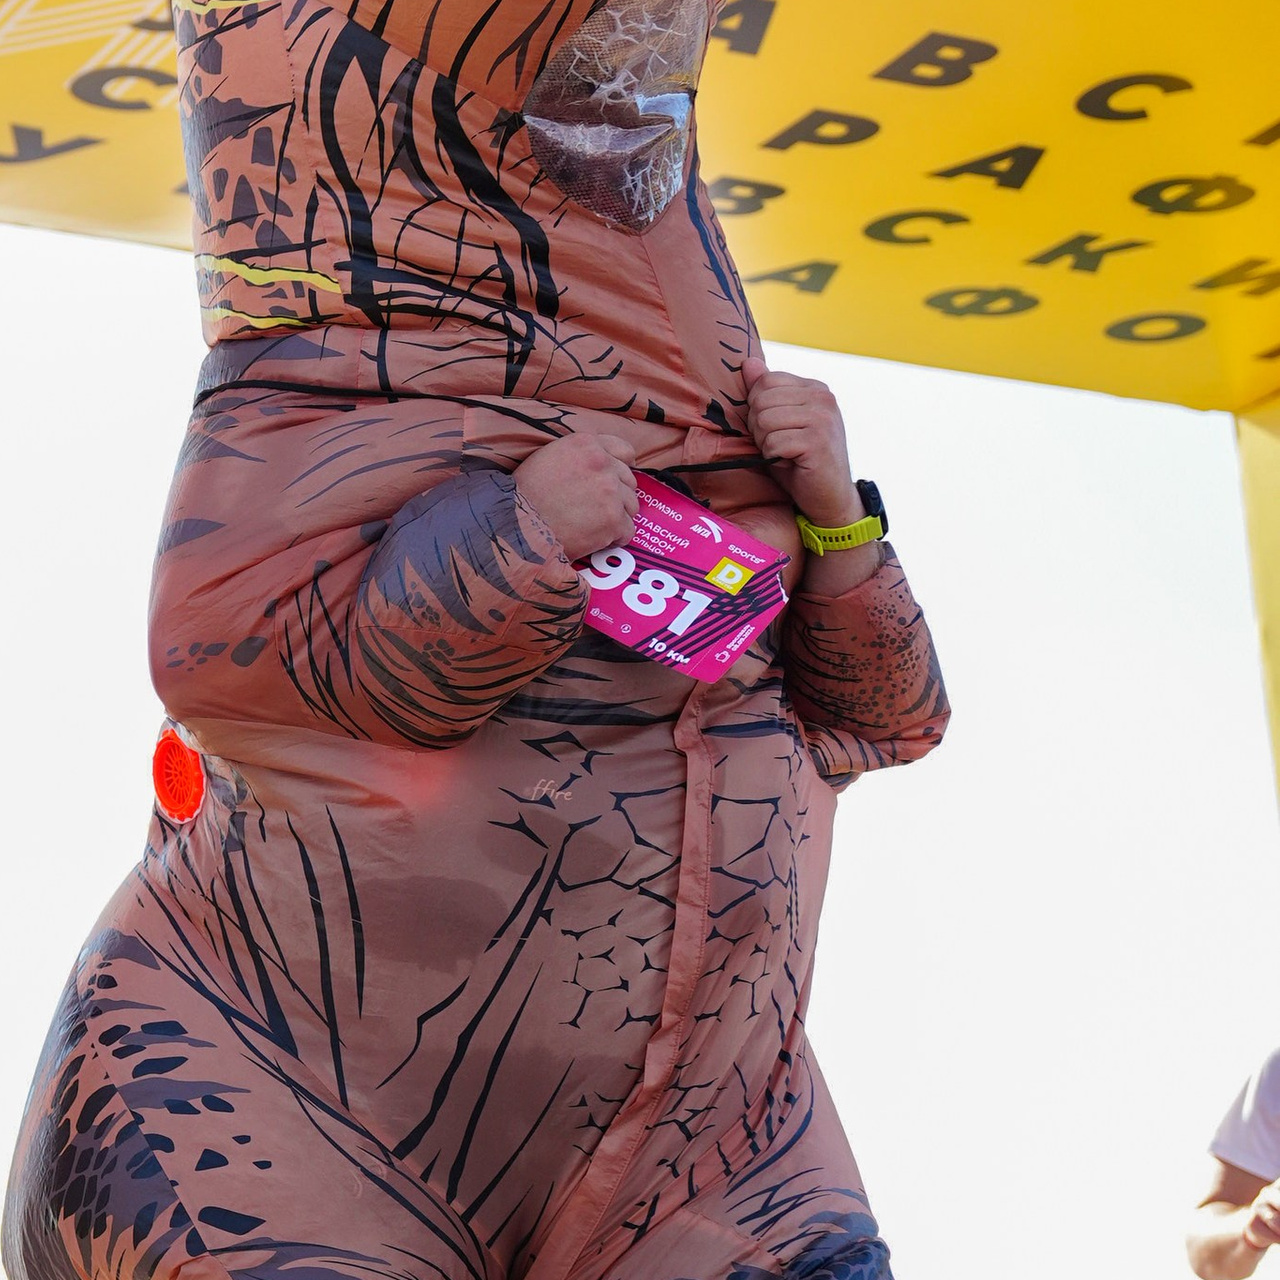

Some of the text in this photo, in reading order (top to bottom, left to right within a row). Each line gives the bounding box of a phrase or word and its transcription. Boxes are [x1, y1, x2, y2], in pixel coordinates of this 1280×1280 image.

[632, 513, 690, 549] СЛАВСКИЙ
[689, 523, 712, 539] ANTA
[633, 536, 666, 557] ОЛЬЦО»
[728, 544, 765, 565] sports
[719, 563, 744, 585] D
[649, 637, 667, 653] 10
